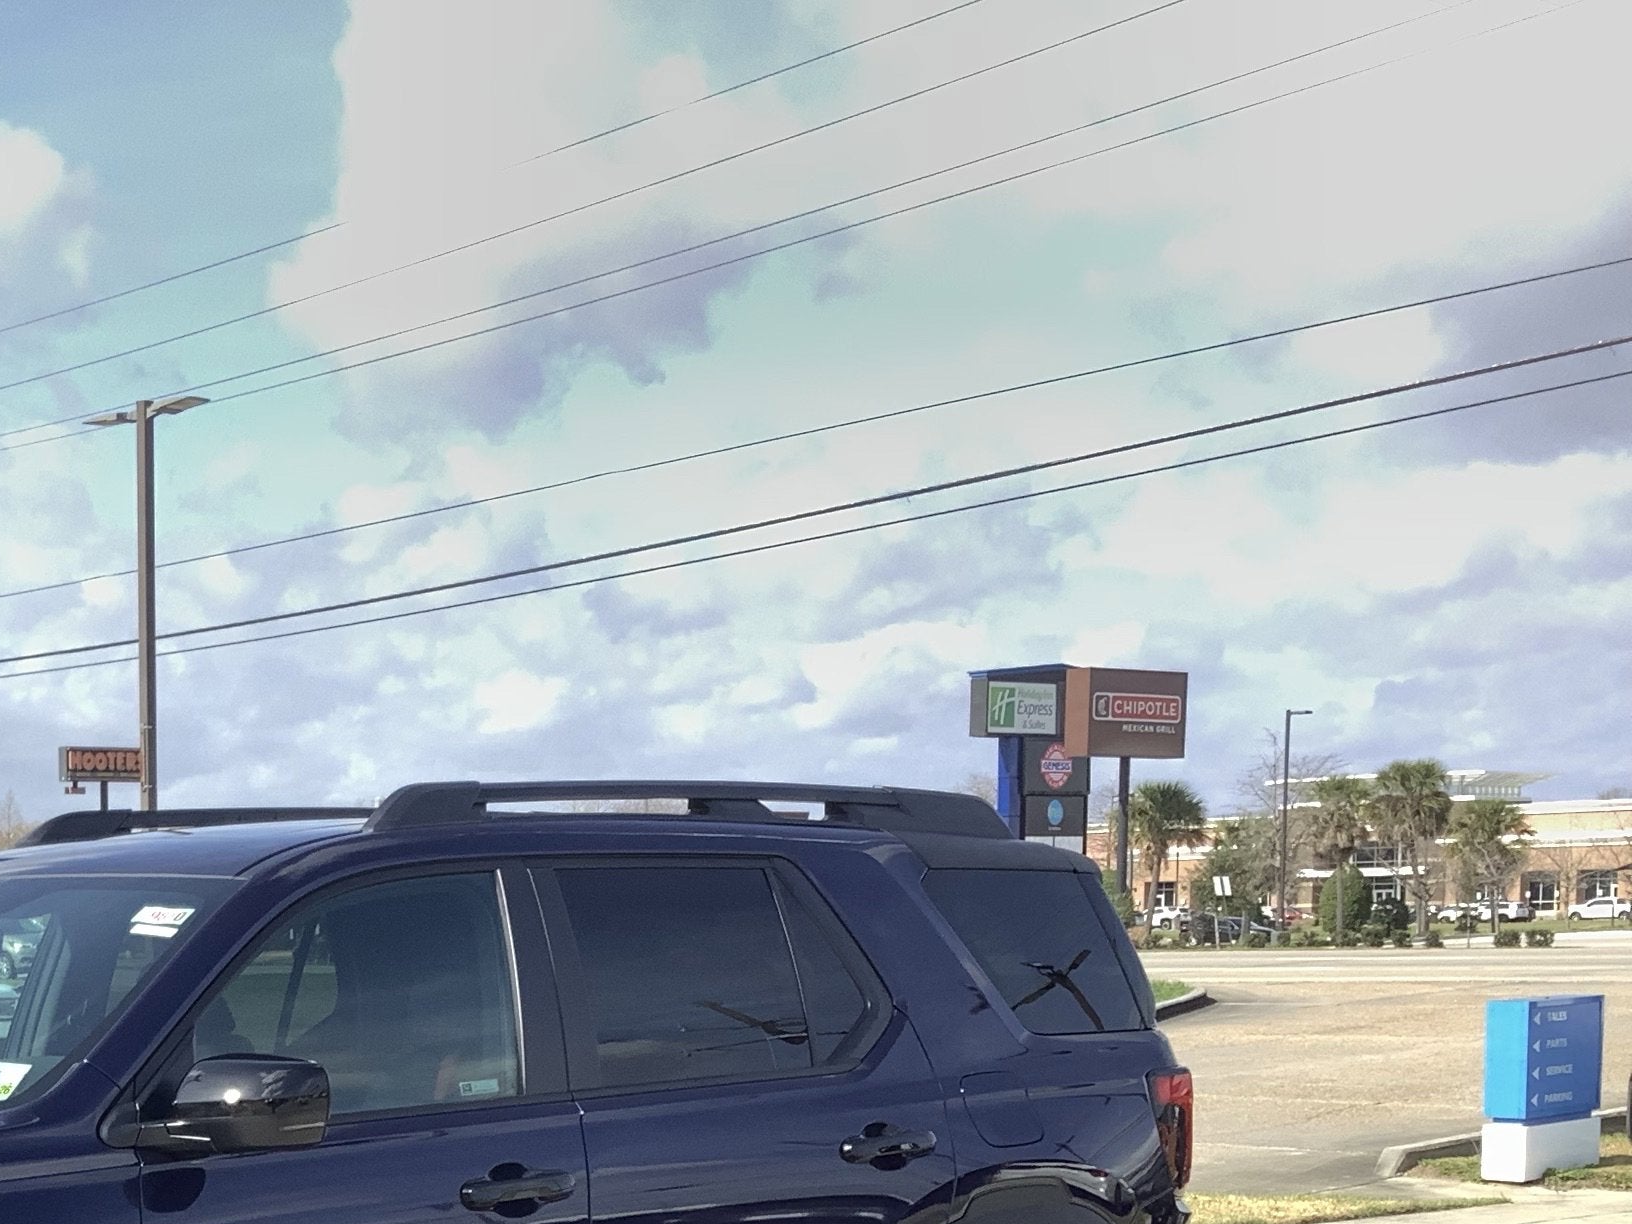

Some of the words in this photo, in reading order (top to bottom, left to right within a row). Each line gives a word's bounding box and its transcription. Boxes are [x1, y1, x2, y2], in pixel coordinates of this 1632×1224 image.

[1017, 699, 1054, 718] Express
[1114, 700, 1178, 716] CHIPOTLE
[1043, 761, 1071, 771] GENESIS
[1545, 1037, 1568, 1049] PARTS
[1546, 1064, 1573, 1076] SERVICE
